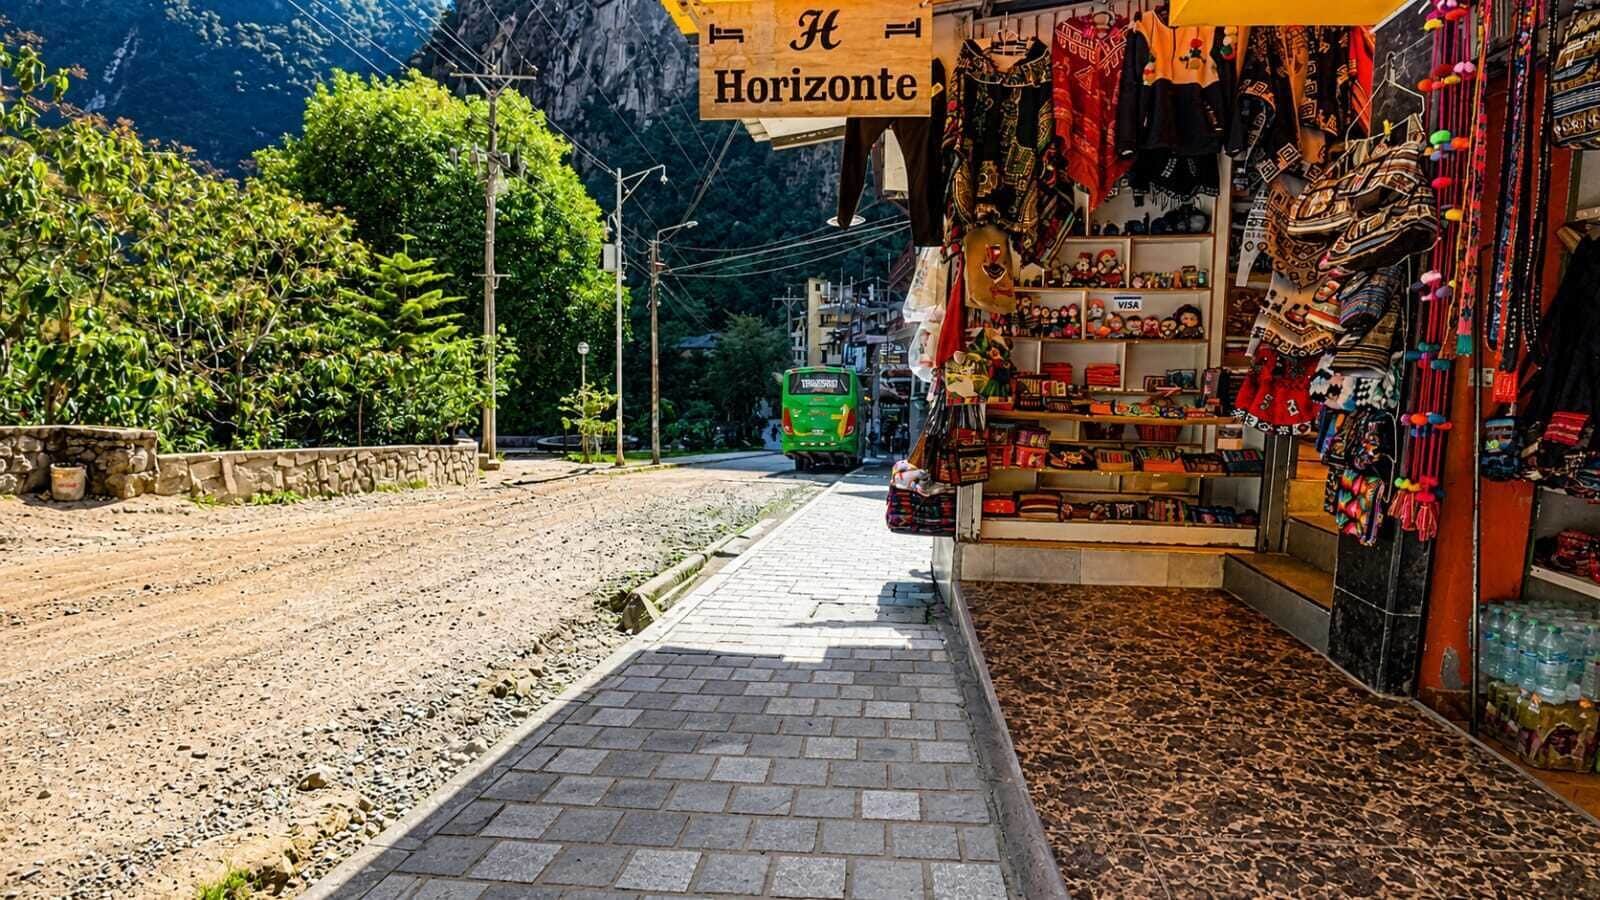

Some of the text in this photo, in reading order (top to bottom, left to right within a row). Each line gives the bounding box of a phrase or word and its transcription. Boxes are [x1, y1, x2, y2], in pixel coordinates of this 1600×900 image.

[789, 9, 842, 51] H
[714, 68, 917, 104] Horizonte
[1118, 300, 1140, 309] VISA
